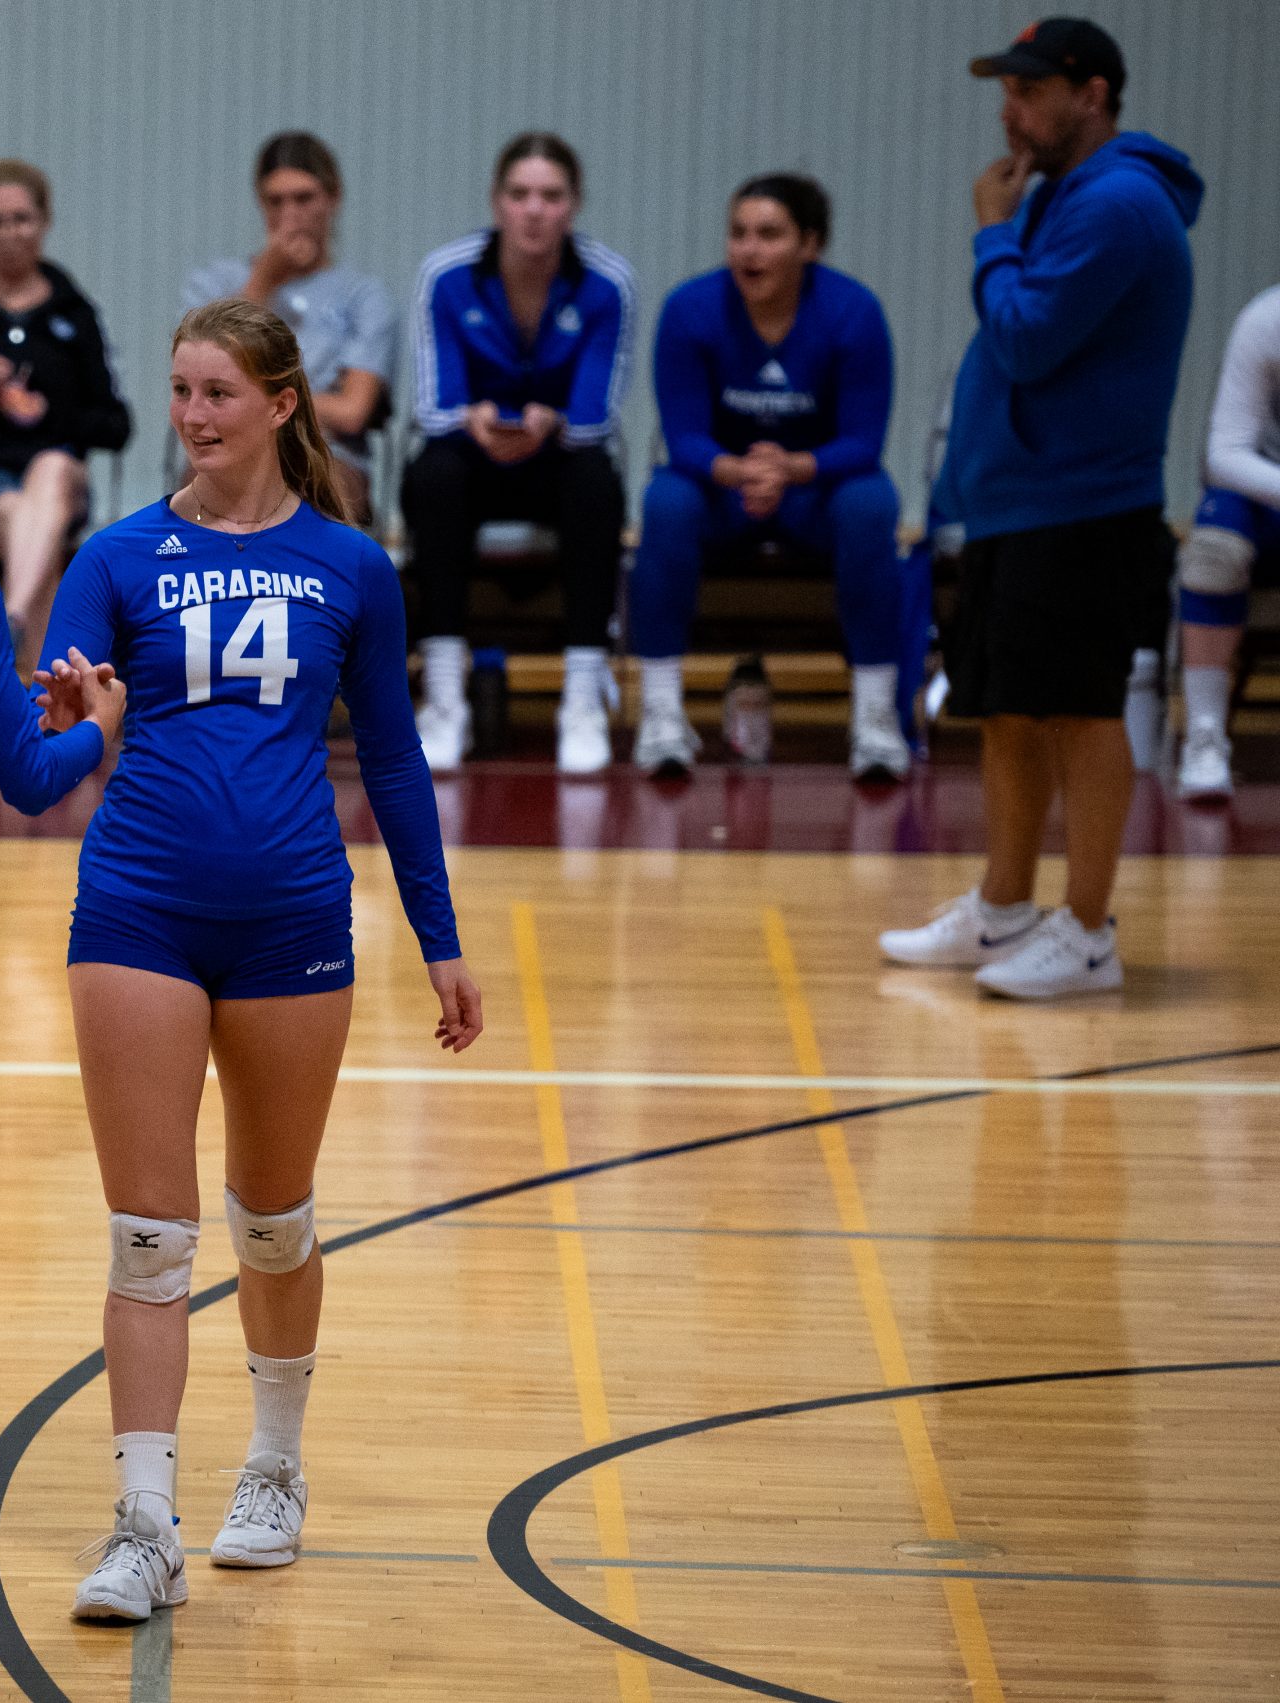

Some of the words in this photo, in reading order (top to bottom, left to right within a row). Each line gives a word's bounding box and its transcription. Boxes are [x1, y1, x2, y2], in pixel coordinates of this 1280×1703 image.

[155, 545, 188, 555] adidas
[157, 569, 325, 610] CARABINS
[180, 597, 299, 705] 14
